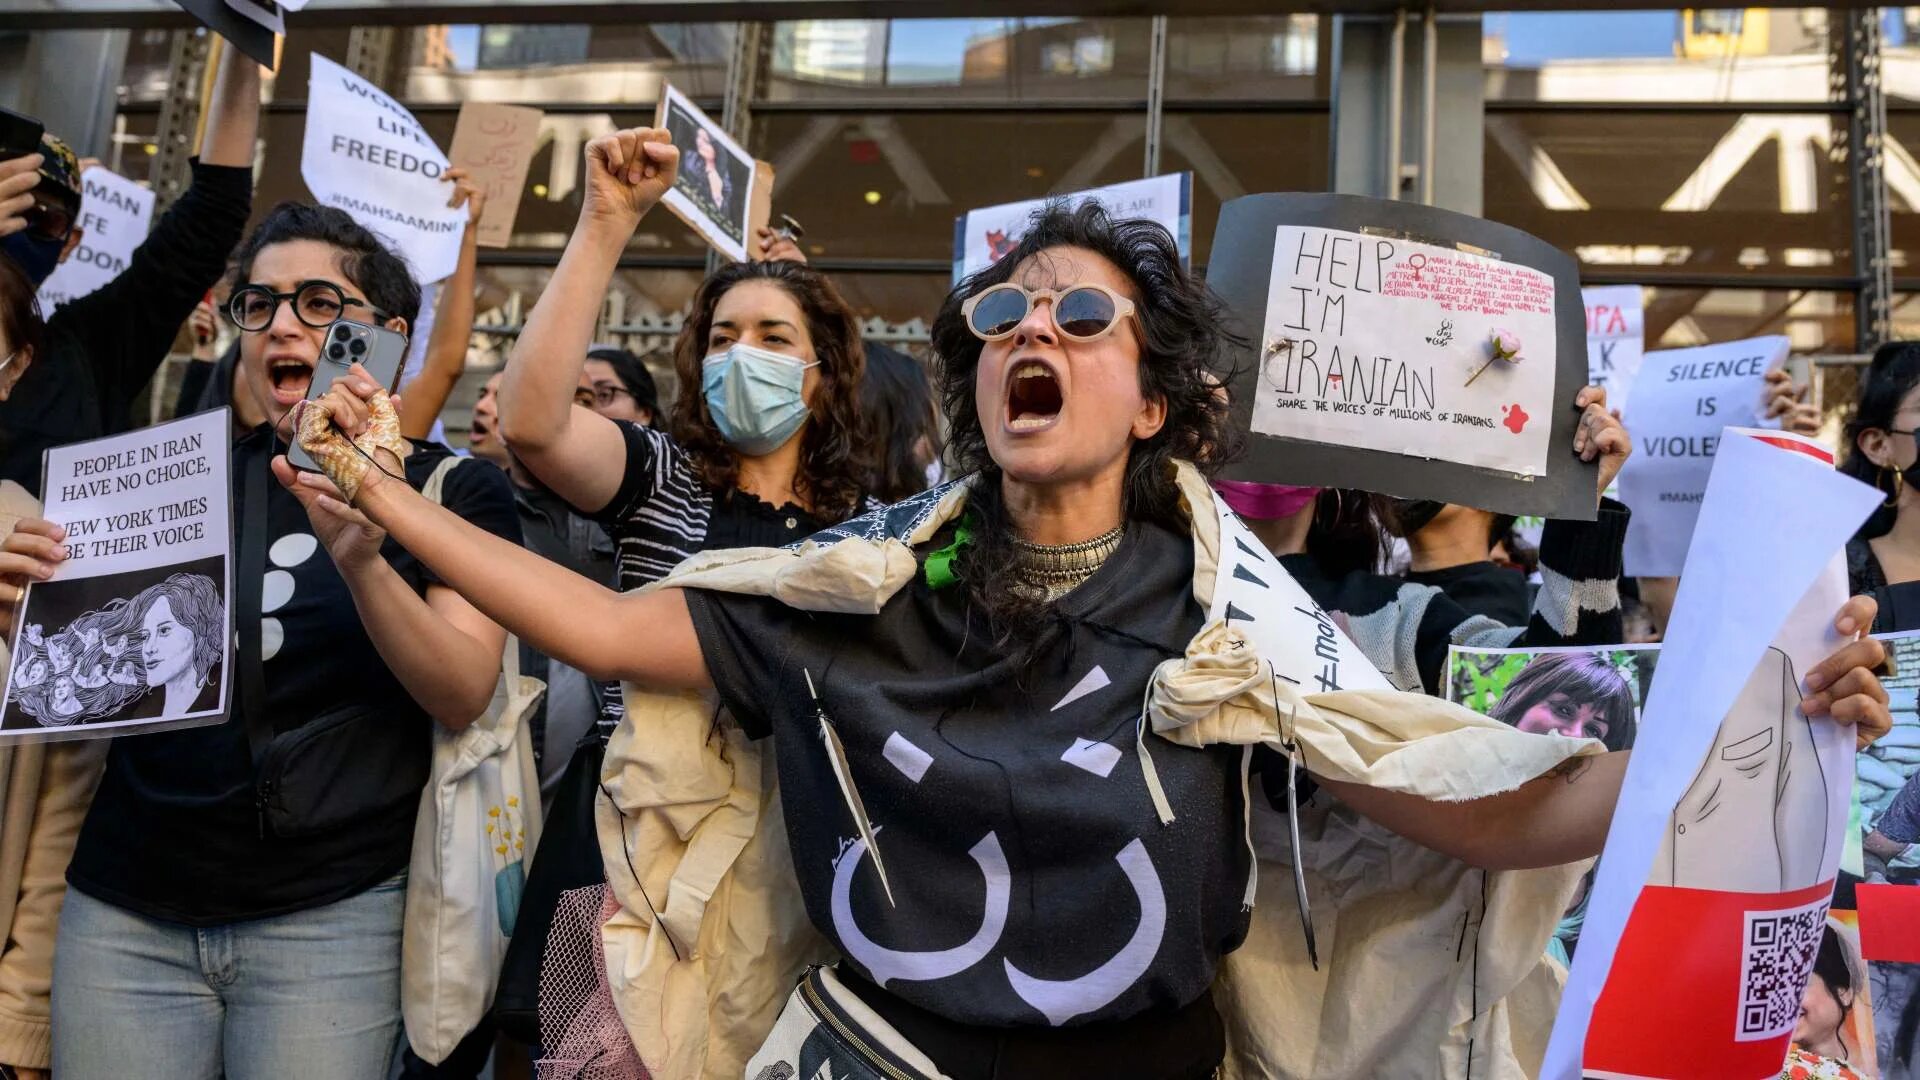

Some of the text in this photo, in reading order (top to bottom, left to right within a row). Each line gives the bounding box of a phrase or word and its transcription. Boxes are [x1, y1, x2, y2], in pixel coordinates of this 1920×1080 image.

[378, 115, 428, 147] LIFE
[331, 134, 451, 180] FREEDO
[85, 180, 140, 216] MAN
[1296, 232, 1394, 294] HELP
[1284, 286, 1345, 337] I'M
[1440, 303, 1453, 311] WE
[1275, 338, 1435, 410] IRANIAN
[1667, 356, 1764, 382] SILENCE
[1276, 398, 1308, 410] SHARE
[1313, 399, 1329, 411] THE
[1333, 401, 1366, 415] VOICES
[1373, 407, 1386, 417] OF
[1389, 409, 1432, 421] MILLIONS
[1438, 412, 1449, 422] OF
[1696, 397, 1716, 416] IS
[73, 433, 203, 478] PEOPLE IN IRAN
[1643, 436, 1721, 457] VIOLE
[61, 456, 211, 502] HAVE NO CHOICE,
[105, 507, 153, 533] YORK
[158, 496, 208, 522] TIMES
[63, 522, 203, 561] BE THEIR VOICE
